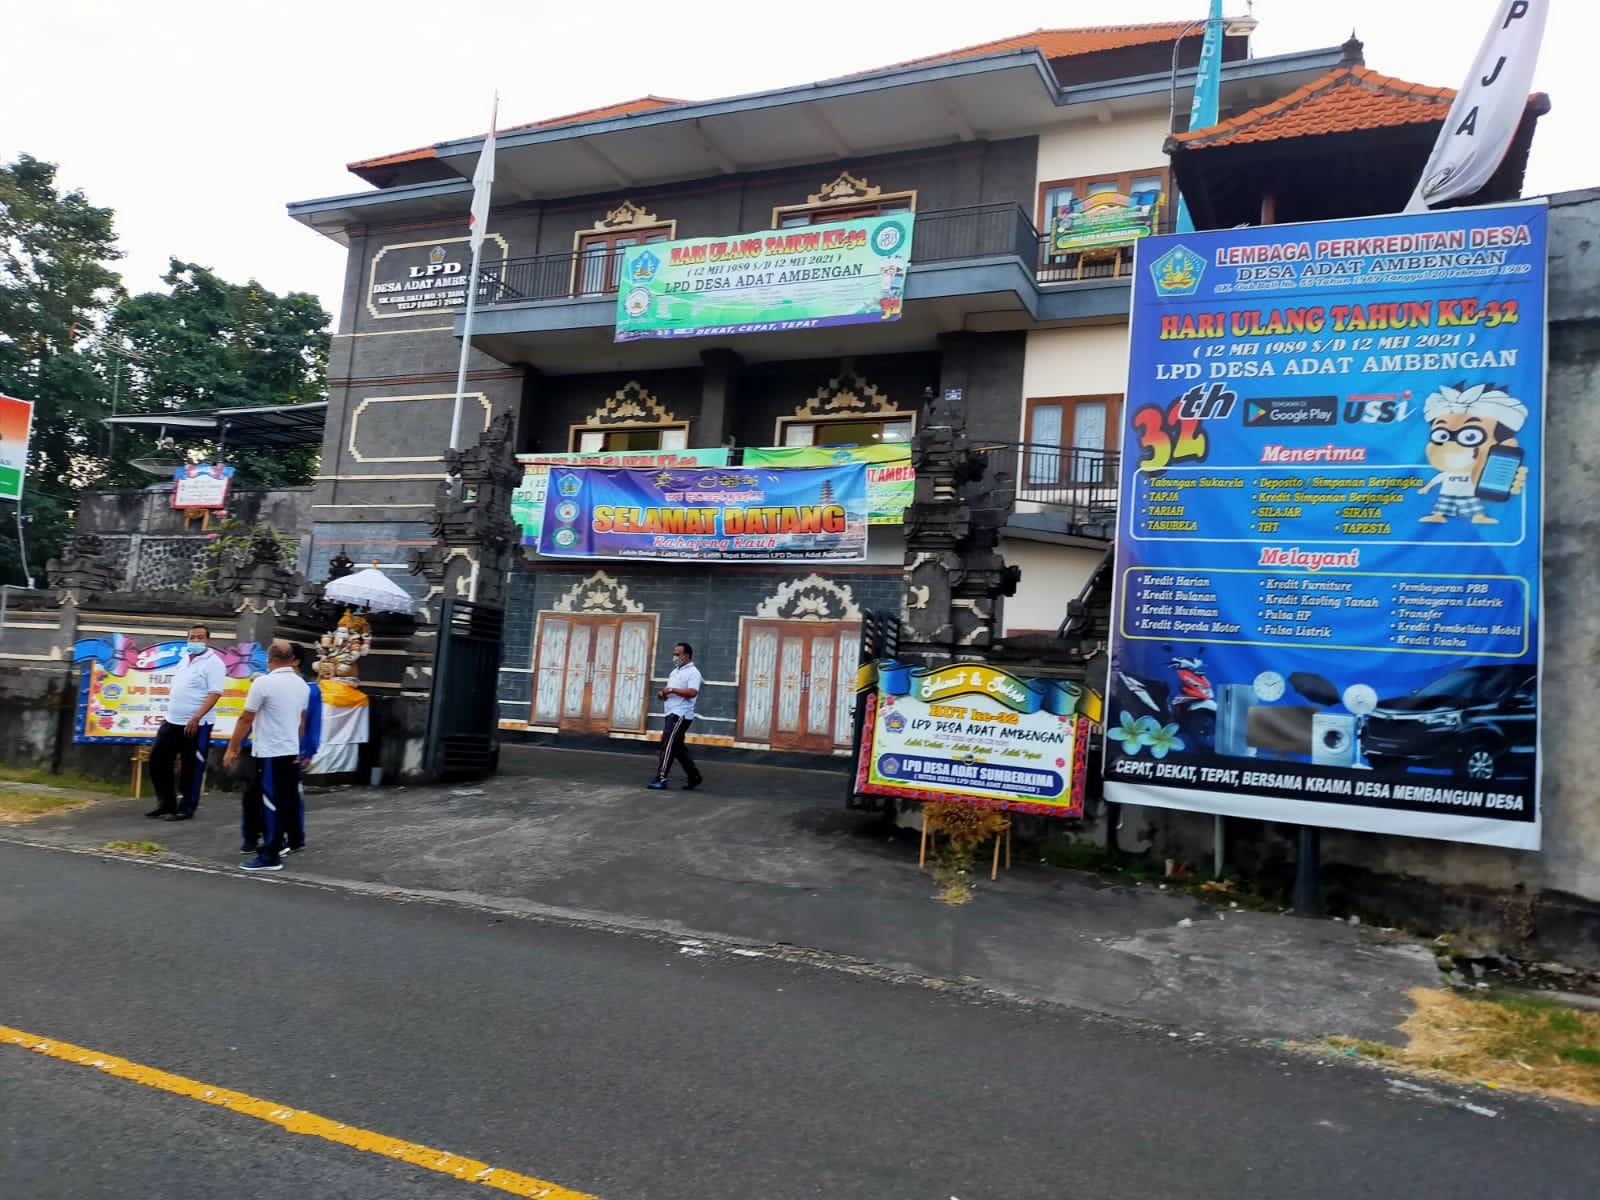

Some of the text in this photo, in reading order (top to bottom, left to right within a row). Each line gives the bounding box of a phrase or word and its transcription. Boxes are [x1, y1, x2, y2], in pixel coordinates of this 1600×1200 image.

[669, 247, 708, 266] HARI
[709, 238, 762, 262] ULANG
[764, 230, 820, 256] TAHUN
[822, 228, 867, 250] KE-32
[1216, 225, 1531, 267] LEMBAGA PERKREDITAN DESA
[808, 254, 835, 265] 2021
[1238, 251, 1507, 282] DESA ADAT AMBENGAN
[408, 262, 462, 278] LPD
[664, 263, 863, 293] LPD DESA ADAT AMBENGAN
[373, 280, 434, 294] DESA ADAT
[1160, 299, 1519, 340] HARI ULANG TAHUN KE-32
[1204, 345, 1226, 357] 12
[1229, 343, 1260, 356] MEI
[1264, 341, 1307, 355] 1989
[1311, 338, 1347, 352] S/D
[1352, 337, 1374, 350] 12
[1377, 336, 1410, 349] MEI
[1415, 334, 1462, 347] 2021
[1156, 349, 1519, 380] LPD DESA ADAT AMBENGAN
[1270, 407, 1333, 422] Google Play
[1260, 445, 1367, 463] Menerima
[1150, 478, 1196, 490] Tabungan
[1259, 478, 1303, 490] Deposito
[1311, 477, 1365, 490] Simpanan
[1367, 476, 1424, 489] Berjangka
[1258, 491, 1404, 504] Kredit Simpanan Berjangka
[594, 505, 847, 535] SELAMAT DATANG
[653, 536, 777, 551] Rahajeng Rauh
[1260, 549, 1358, 569] Melayani
[1143, 576, 1210, 587] Kredit Harian
[1265, 578, 1352, 591] Kredit Furniture
[1398, 582, 1489, 594] Pembayaran PBB
[1142, 591, 1217, 602] Kredit Bulanan
[1265, 594, 1299, 605] Kredit
[1344, 596, 1380, 608] Tanah
[1397, 596, 1503, 608] Pembayaran Listrik
[1141, 606, 1219, 617] Kredit Musiman
[1264, 609, 1312, 621] Pulsa HP
[1397, 608, 1444, 621] Transfer
[1140, 620, 1241, 633] Kredit Sepeda Motor
[1264, 625, 1333, 638] Pulsa Listrik
[1397, 623, 1521, 636] Kredit Pembelian Mobil
[1396, 636, 1467, 648] Kredit Usaha
[928, 705, 968, 719] HUT
[911, 719, 931, 730] LPD
[935, 722, 963, 734] DESA
[966, 725, 997, 738] ADAT
[999, 728, 1065, 744] AMBENGAN
[902, 759, 922, 772] LPD
[923, 761, 950, 776] DESA
[951, 764, 980, 779] ADAT
[979, 767, 1054, 788] SUMBERKIMA
[1115, 760, 1525, 811] CEPAT, DEKAT, TEPAT, BERSAMA KRAMA DESA MEMBANGUN DESA
